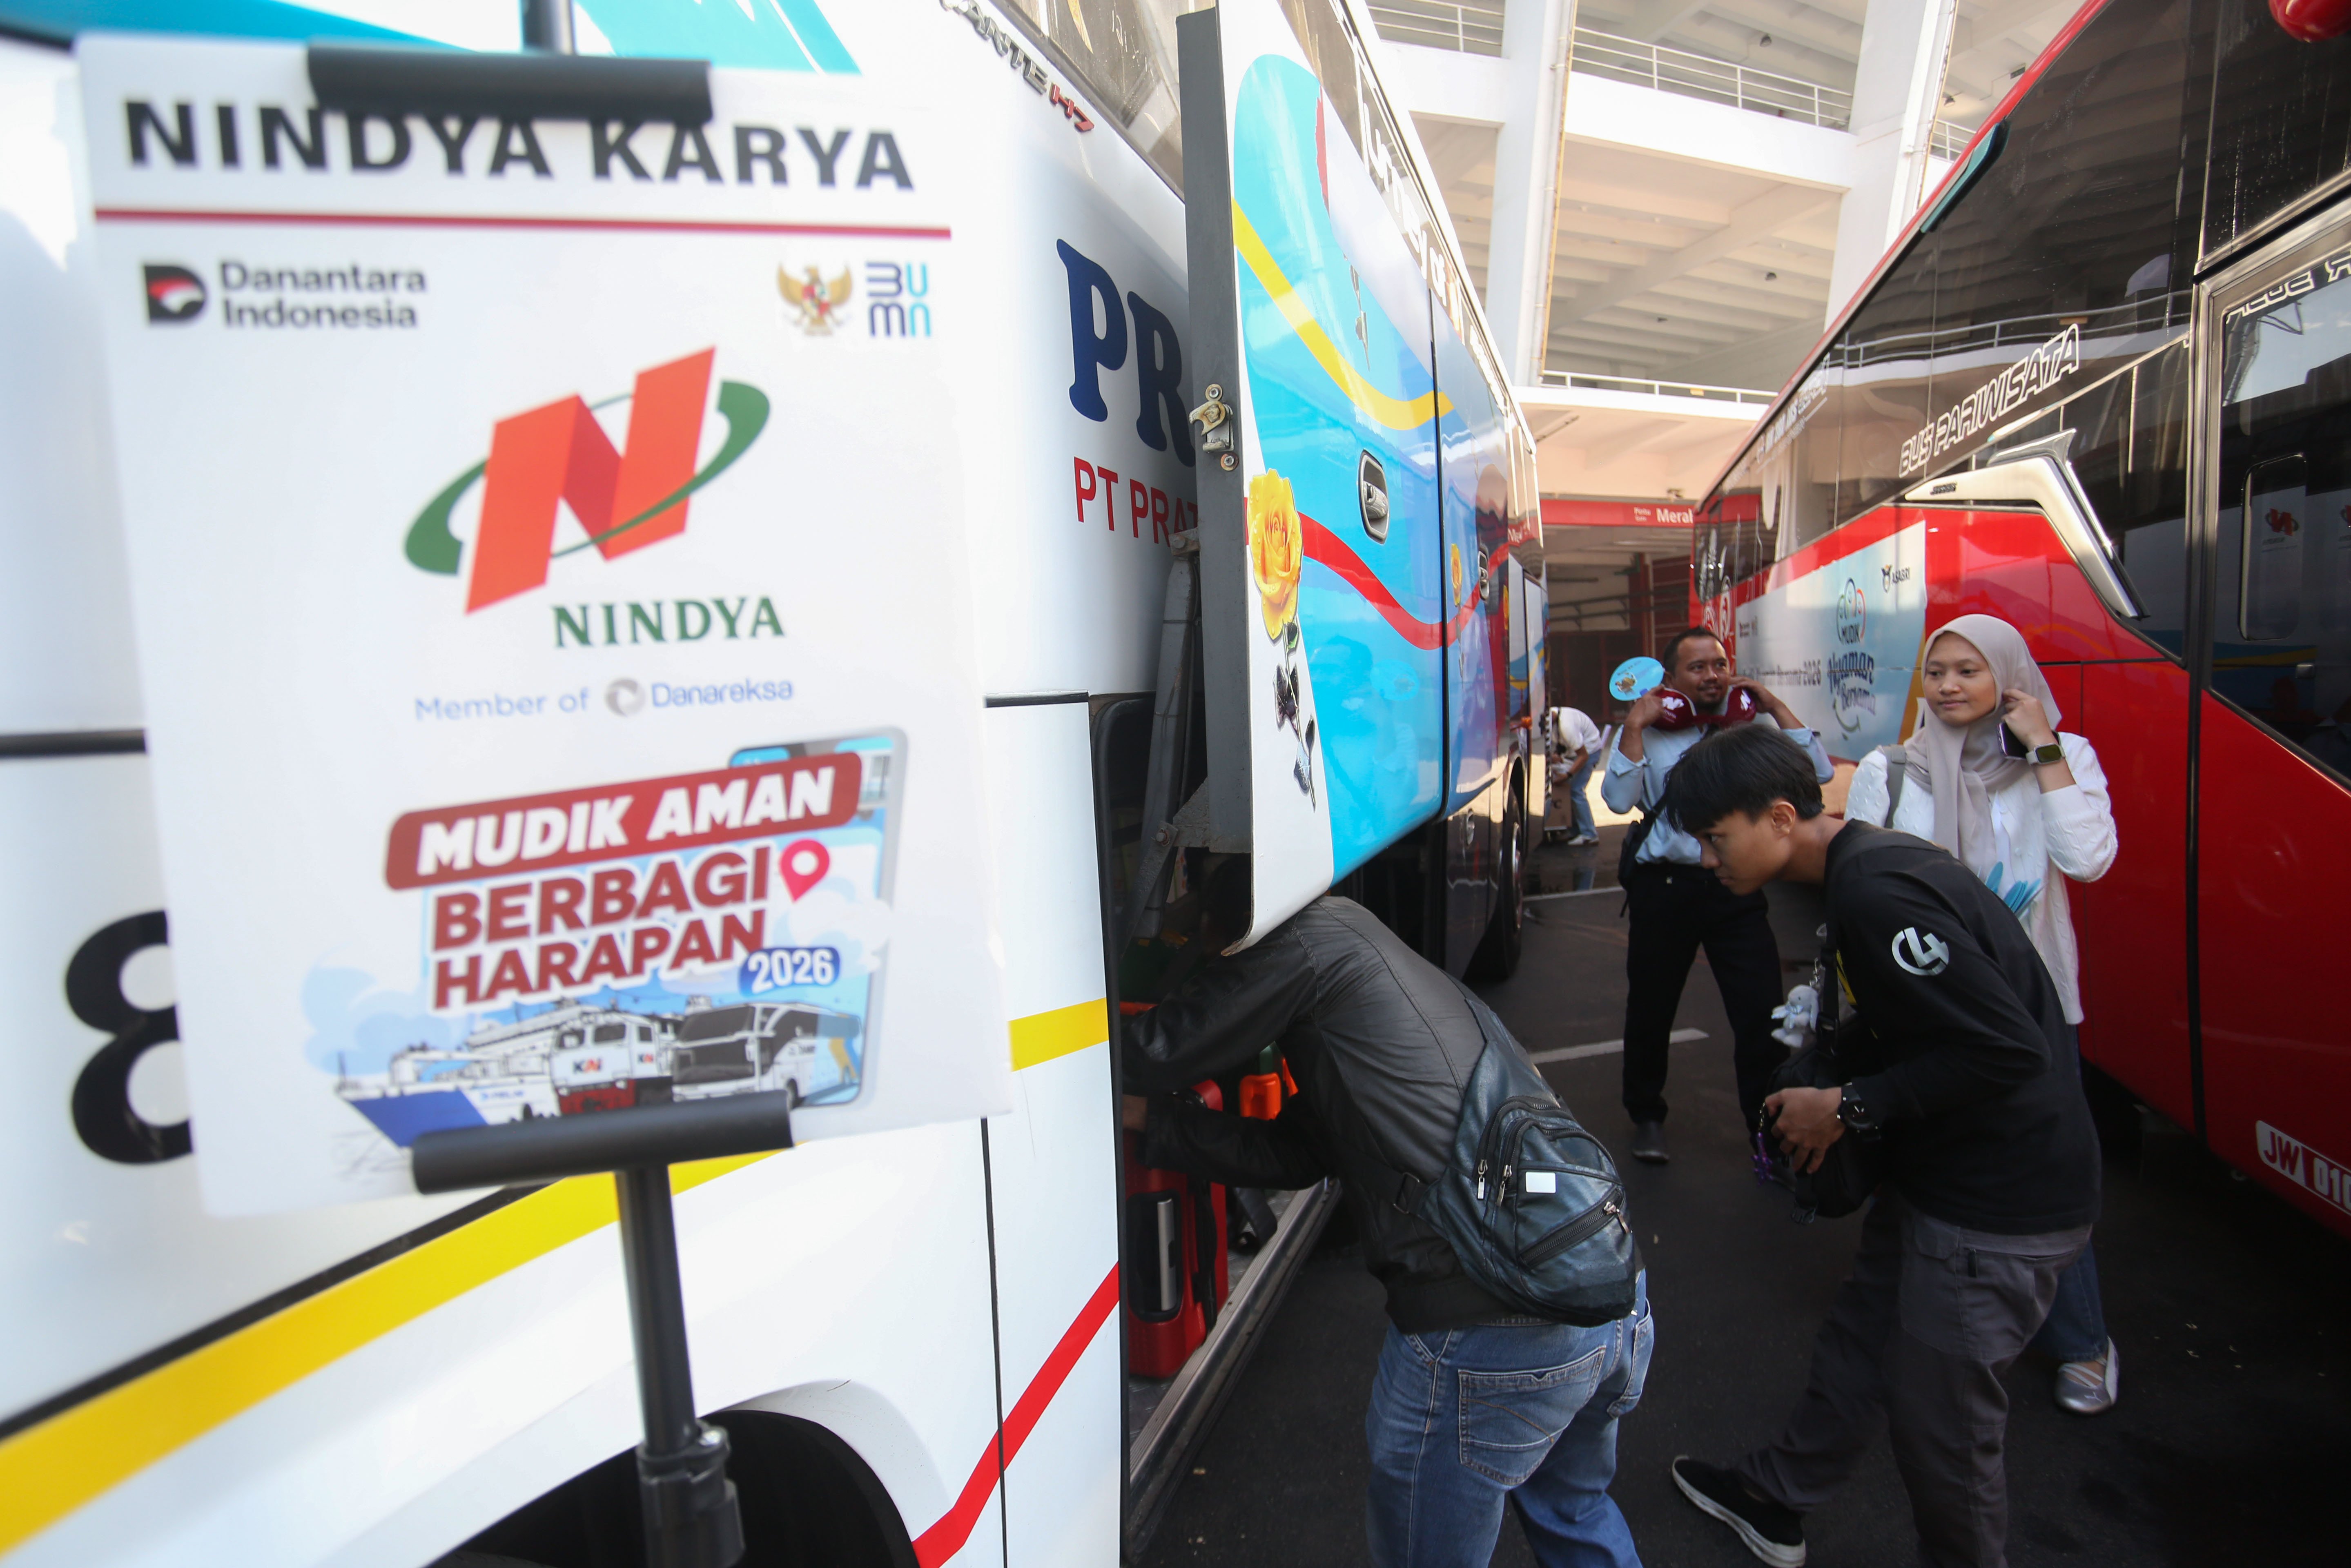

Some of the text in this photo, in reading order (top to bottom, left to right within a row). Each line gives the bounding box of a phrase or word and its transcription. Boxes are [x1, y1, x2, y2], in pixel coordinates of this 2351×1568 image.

[125, 100, 916, 191] NINDYA KARYA
[218, 261, 428, 294] Danantara
[221, 297, 419, 330] Indonesia
[1899, 416, 1934, 479] BUS
[1934, 323, 2079, 457] PARIWISATA
[1074, 456, 1118, 532] PT
[552, 596, 785, 648] NINDYA
[414, 678, 794, 722] Member of Danareksa
[416, 766, 836, 877] MUDIK AMAN
[433, 846, 771, 951] BERBAGI
[434, 908, 767, 1010] HARAPAN
[747, 948, 834, 993] 2026
[2263, 1131, 2300, 1176] JW
